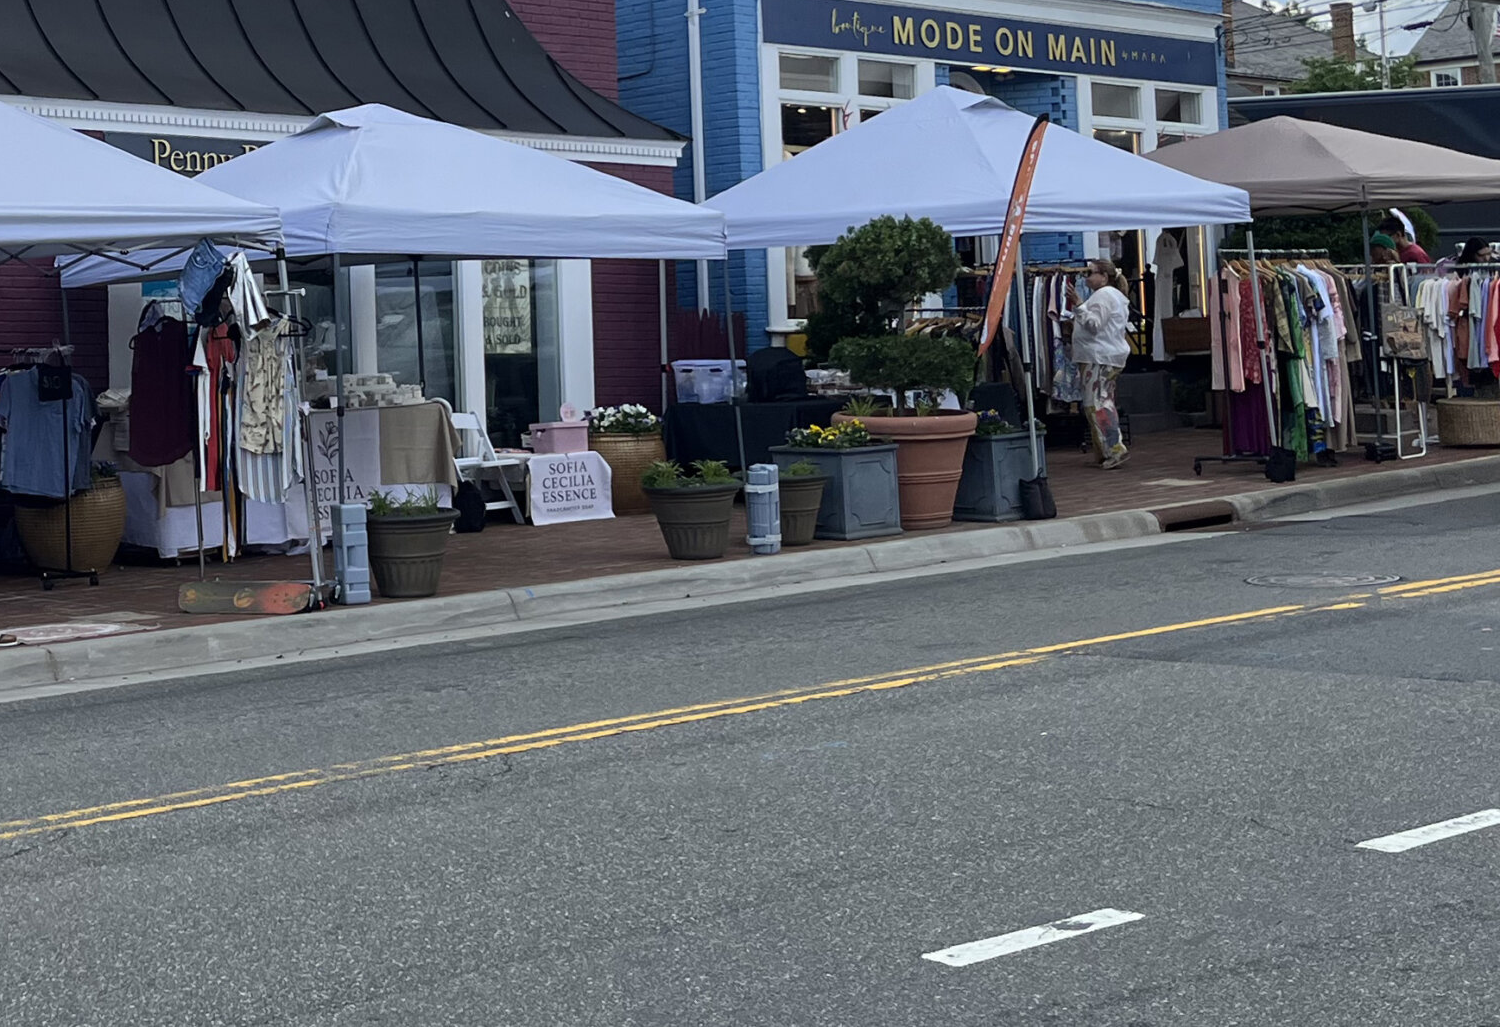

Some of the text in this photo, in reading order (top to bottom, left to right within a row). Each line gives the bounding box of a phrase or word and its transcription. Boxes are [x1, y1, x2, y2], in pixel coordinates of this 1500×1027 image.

[831, 8, 887, 46] boutique
[892, 15, 983, 53] MODE
[994, 27, 1035, 59] ON
[1047, 34, 1117, 67] MAIN
[484, 261, 521, 275] COINS
[493, 285, 527, 299] GOLD
[484, 316, 522, 328] BOUGHT
[496, 334, 521, 345] SOLD
[548, 461, 587, 475] SOFIA
[314, 468, 355, 484] SOFA
[542, 474, 595, 489] CECILIA
[315, 485, 365, 502] ECIIA
[542, 488, 597, 503] ESSENCE
